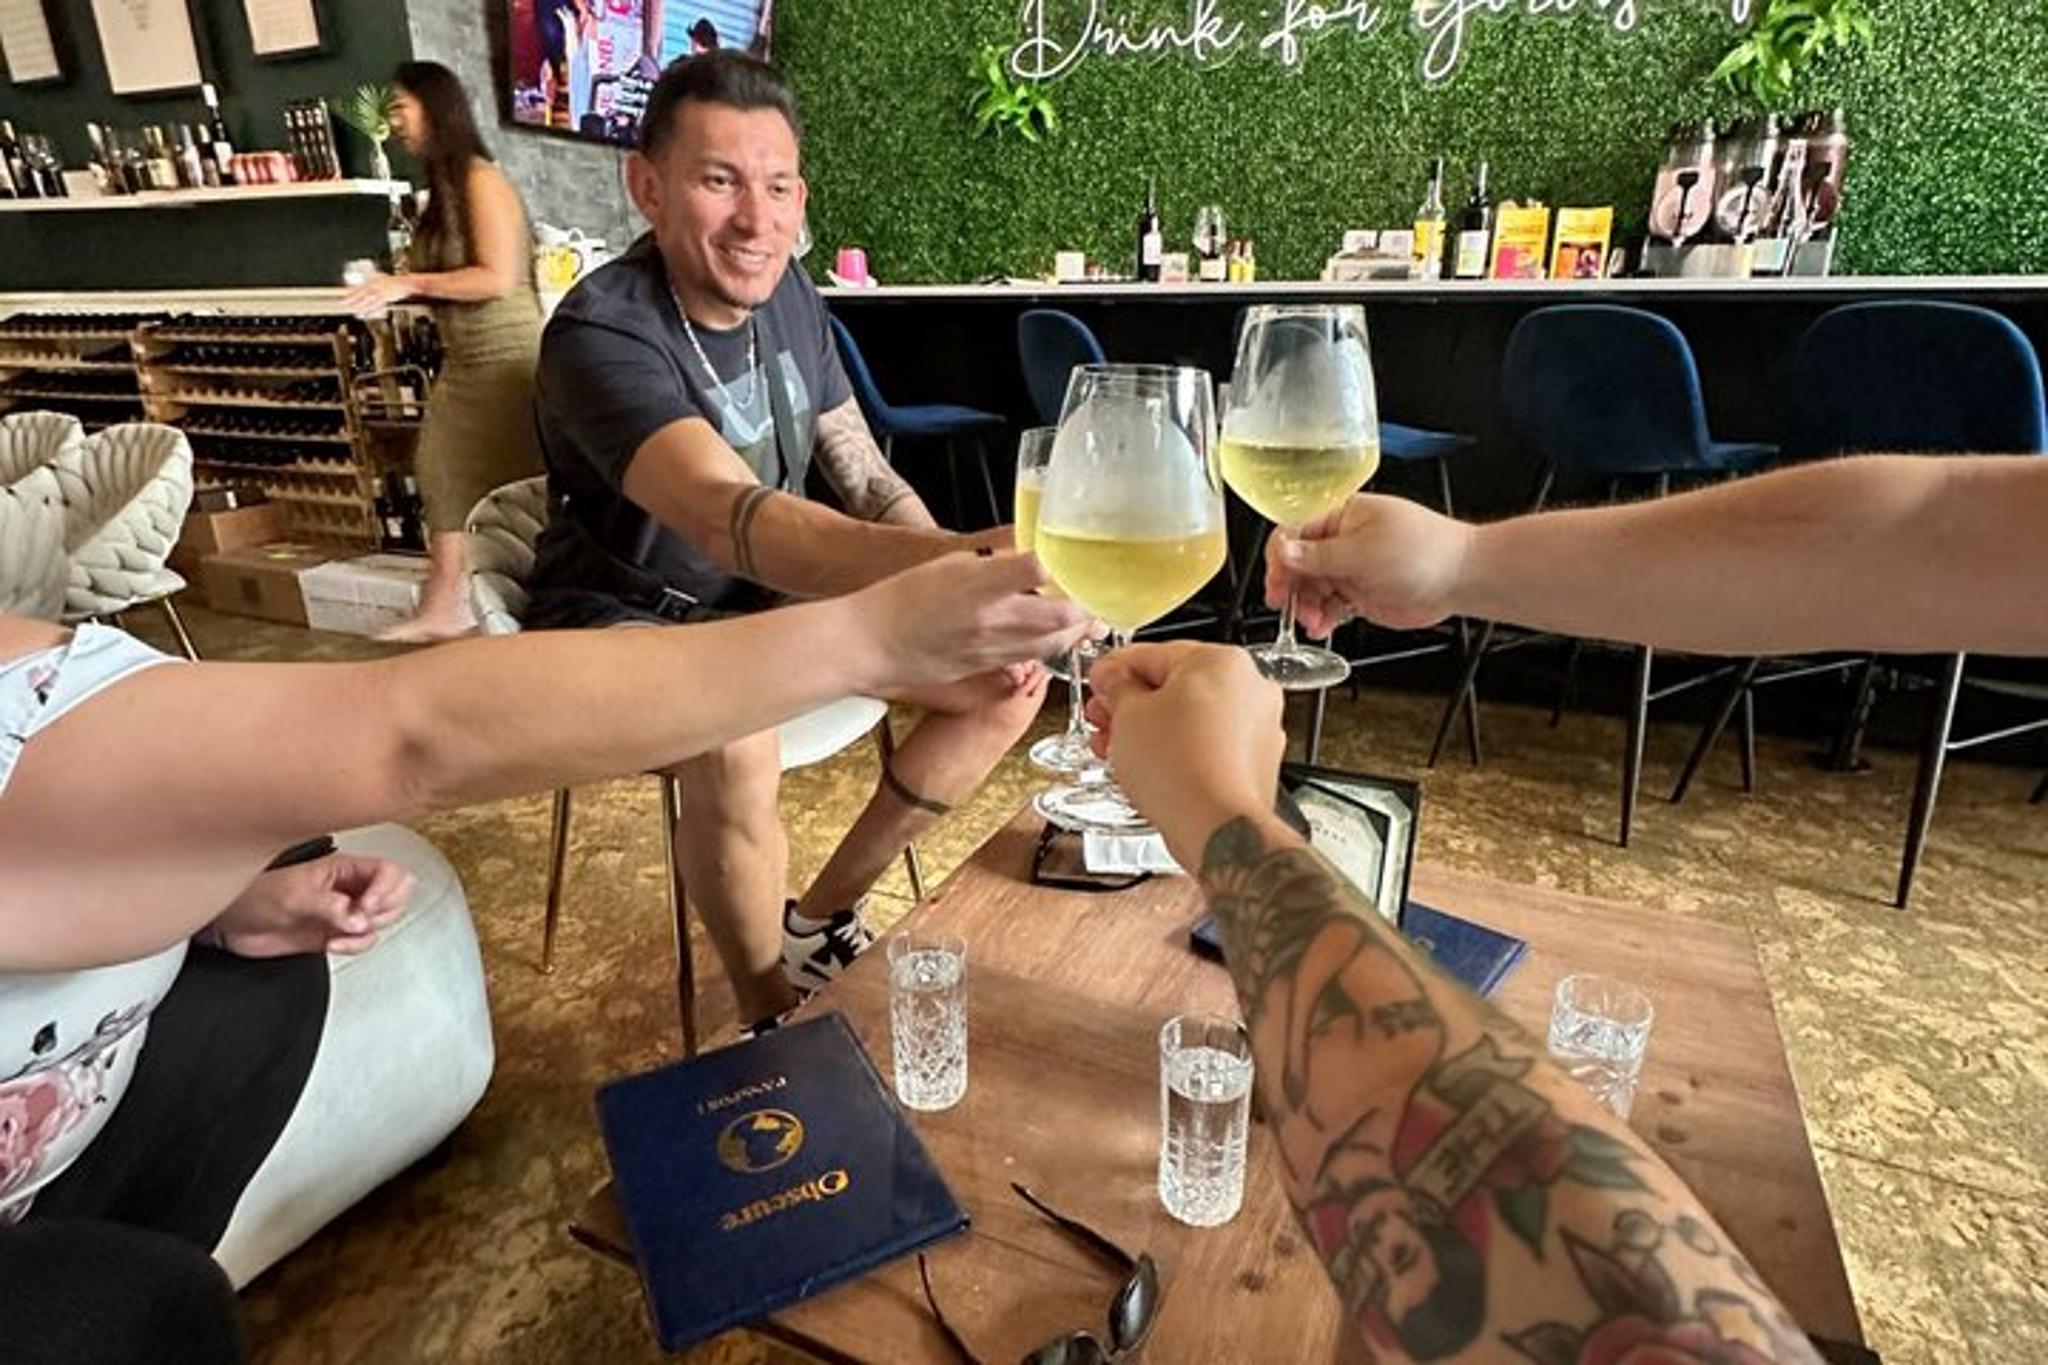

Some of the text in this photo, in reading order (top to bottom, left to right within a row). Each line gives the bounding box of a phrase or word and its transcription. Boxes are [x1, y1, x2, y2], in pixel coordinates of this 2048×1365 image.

[1012, 0, 1246, 77] Drink
[1259, 0, 1381, 65] for
[1432, 1099, 1532, 1194] THE
[718, 1168, 849, 1231] Obscure
